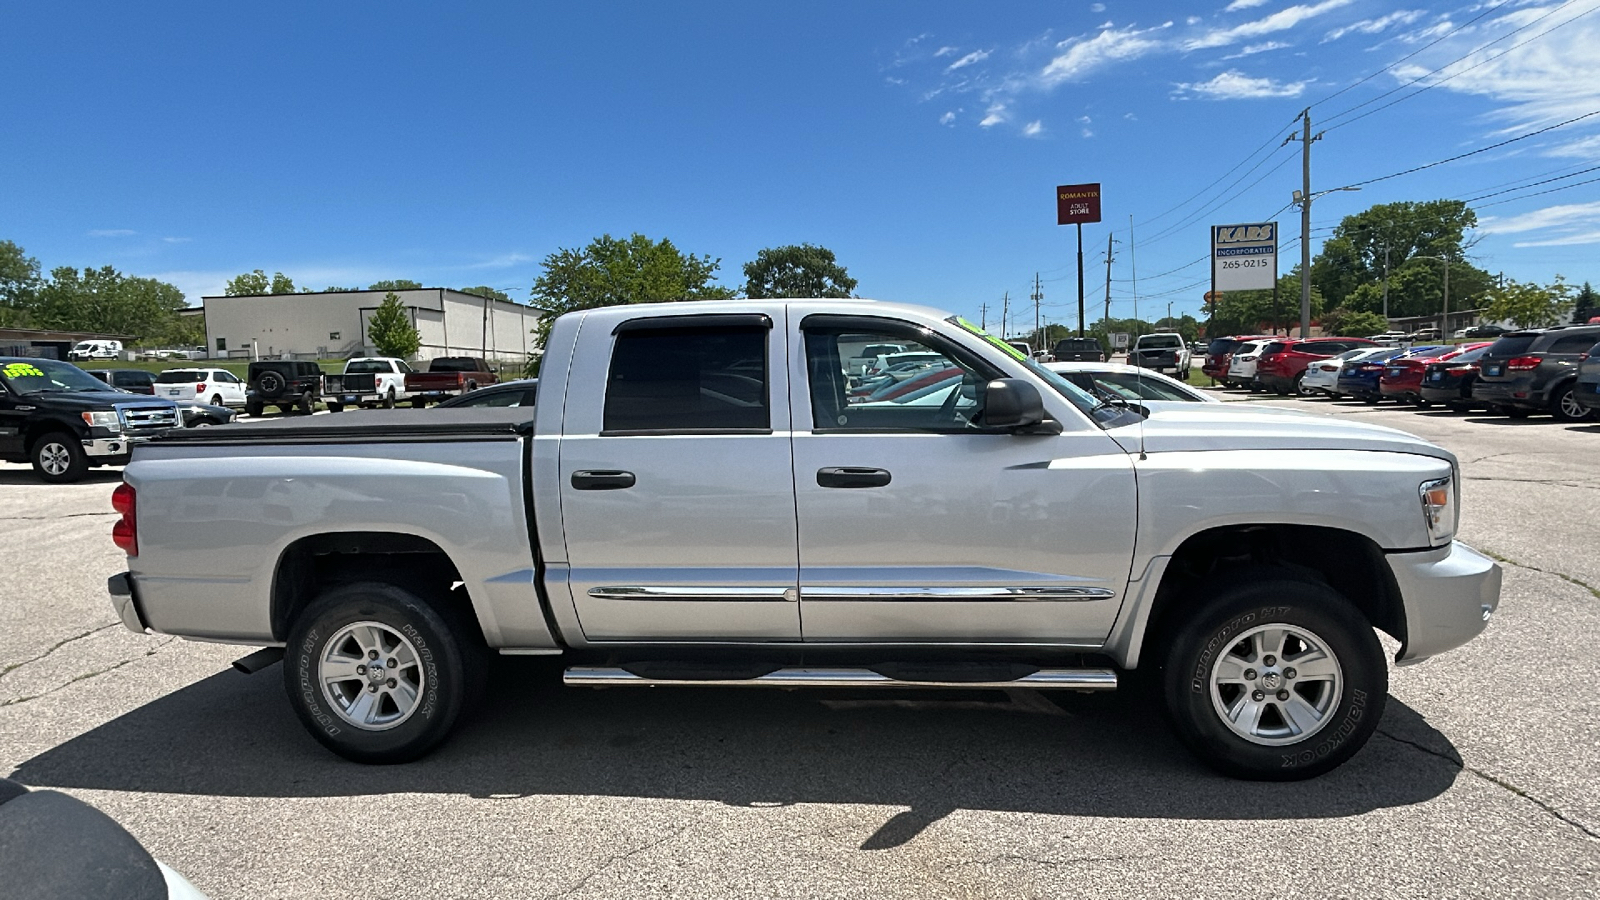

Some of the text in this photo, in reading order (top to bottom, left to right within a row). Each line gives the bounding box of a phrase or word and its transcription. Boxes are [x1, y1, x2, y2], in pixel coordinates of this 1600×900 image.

[1060, 191, 1099, 201] ROMANTIX
[1069, 208, 1090, 216] STORE
[1217, 224, 1272, 243] KARS
[1217, 247, 1273, 256] INCORPORATED
[1222, 258, 1268, 269] 265-0215
